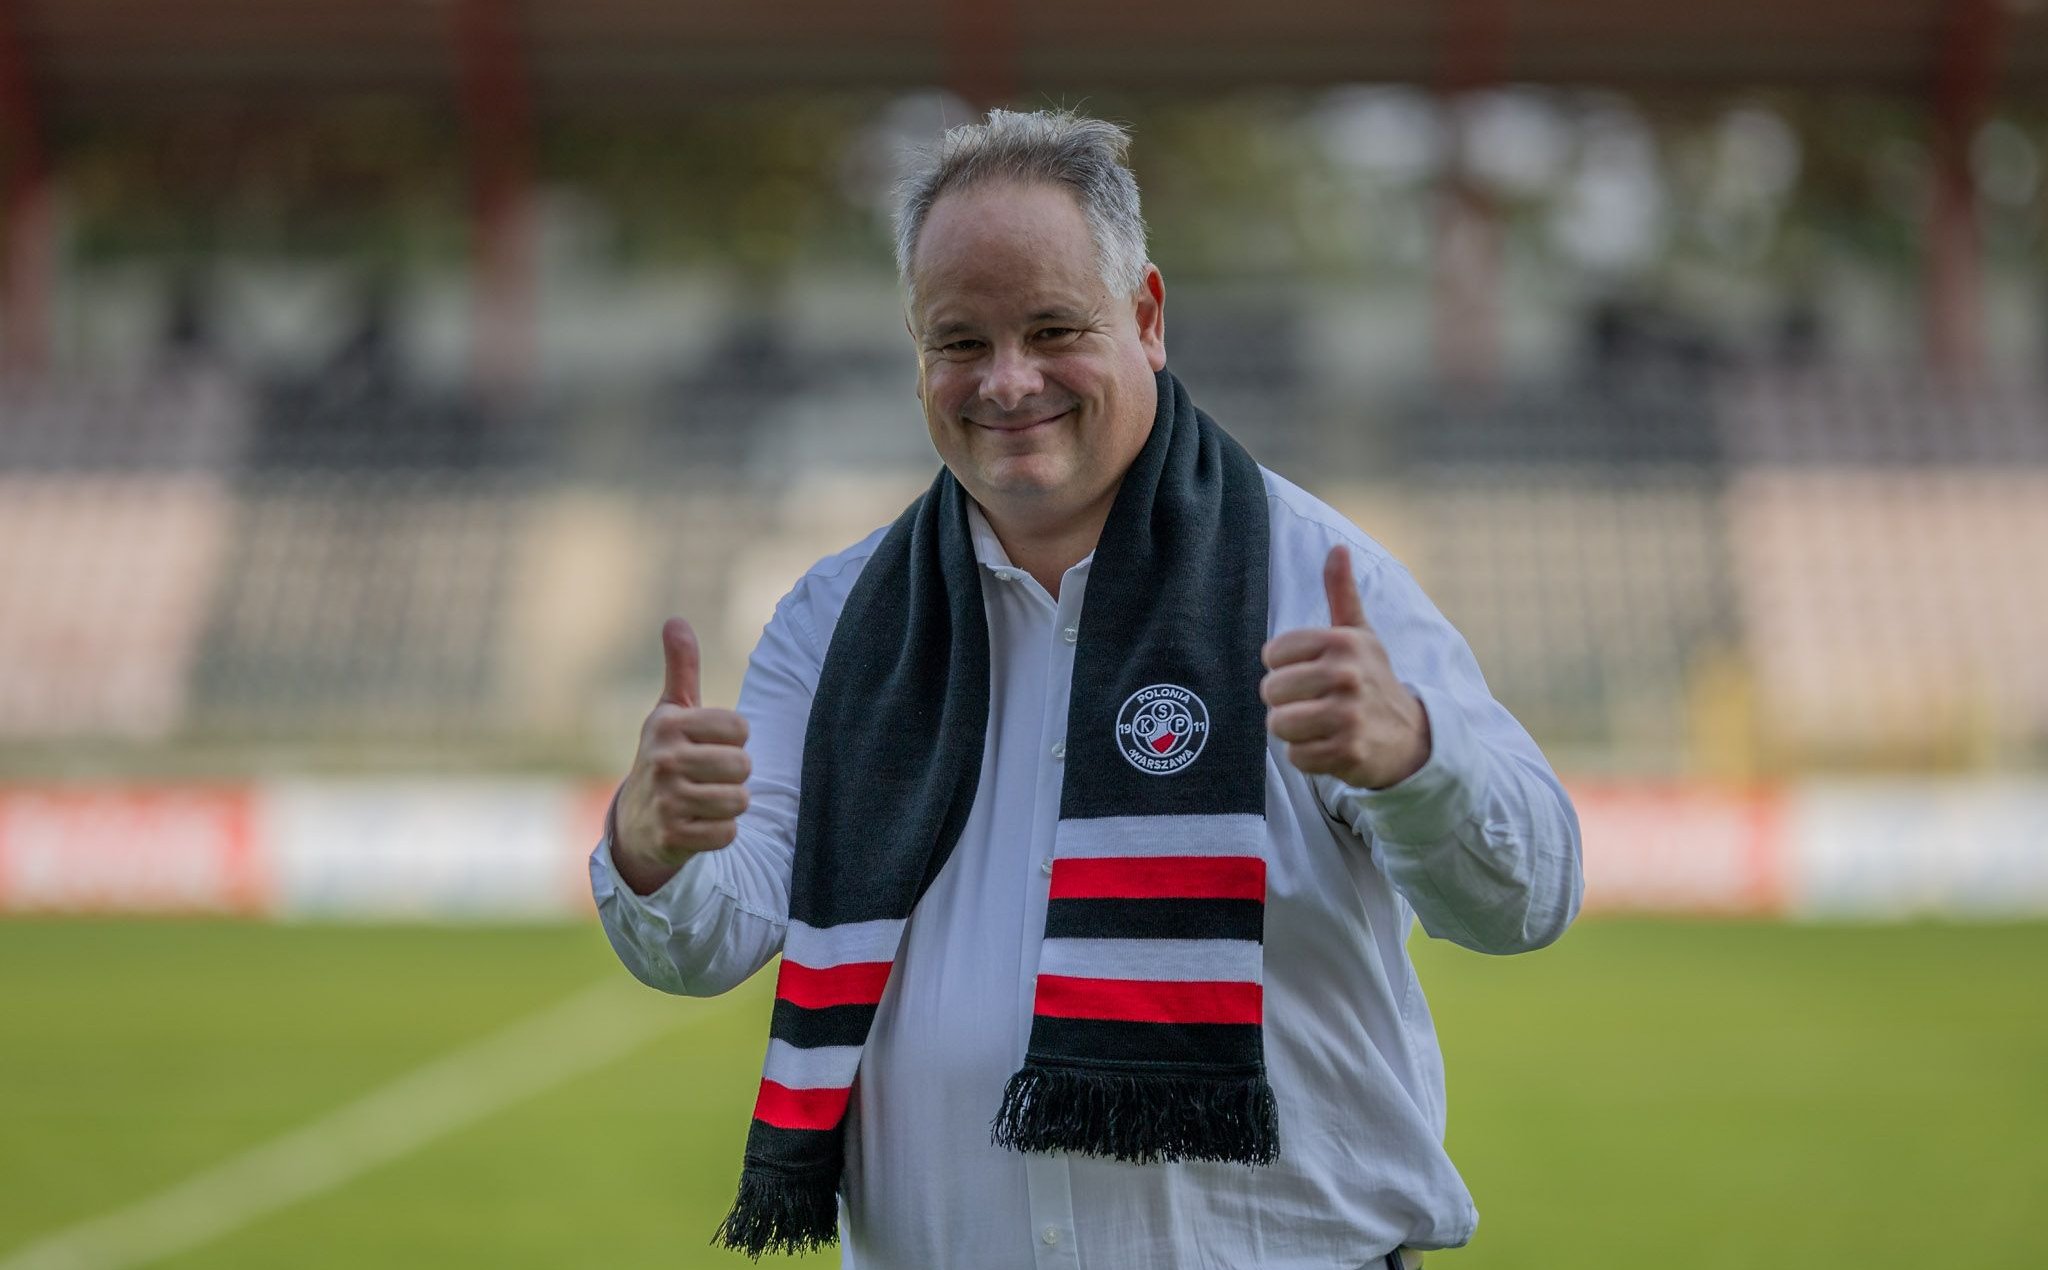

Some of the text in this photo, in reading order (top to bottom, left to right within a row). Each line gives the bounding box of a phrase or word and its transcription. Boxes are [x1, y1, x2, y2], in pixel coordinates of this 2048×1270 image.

[1137, 688, 1191, 704] POLONIA
[1119, 721, 1205, 734] 19 11
[1128, 749, 1194, 769] WARSZAWA
